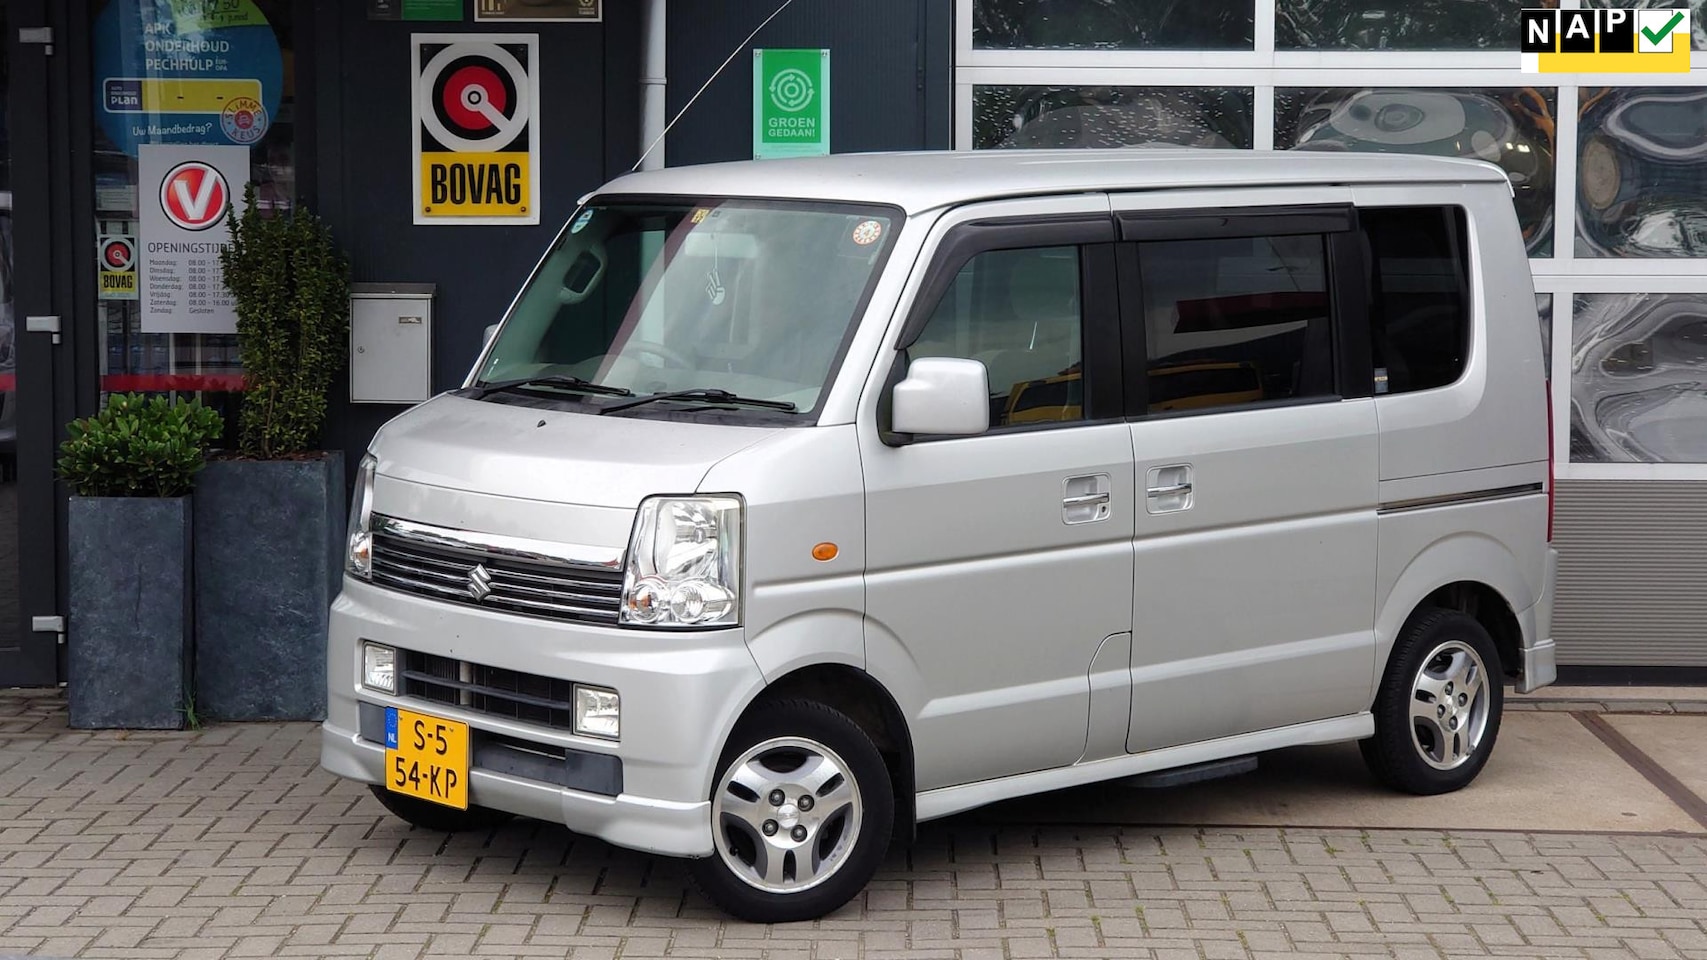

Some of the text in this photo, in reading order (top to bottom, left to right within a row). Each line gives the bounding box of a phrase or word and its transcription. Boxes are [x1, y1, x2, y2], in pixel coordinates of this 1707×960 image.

[144, 23, 171, 35] APK
[145, 41, 230, 53] ONDERHOUD
[145, 58, 213, 71] PECHHULP
[225, 100, 262, 118] SLIMME
[768, 117, 816, 127] GROEN
[132, 122, 213, 136] Uw Maandbedrag?
[231, 126, 260, 139] KEUS
[768, 128, 816, 137] GEDAAN!
[431, 163, 521, 205] BOVAG
[147, 242, 237, 254] OPENINGSTIJDE
[103, 274, 133, 289] BOVAG
[387, 732, 397, 743] NL
[414, 719, 448, 756] S-5
[395, 756, 458, 799] 54-KP
